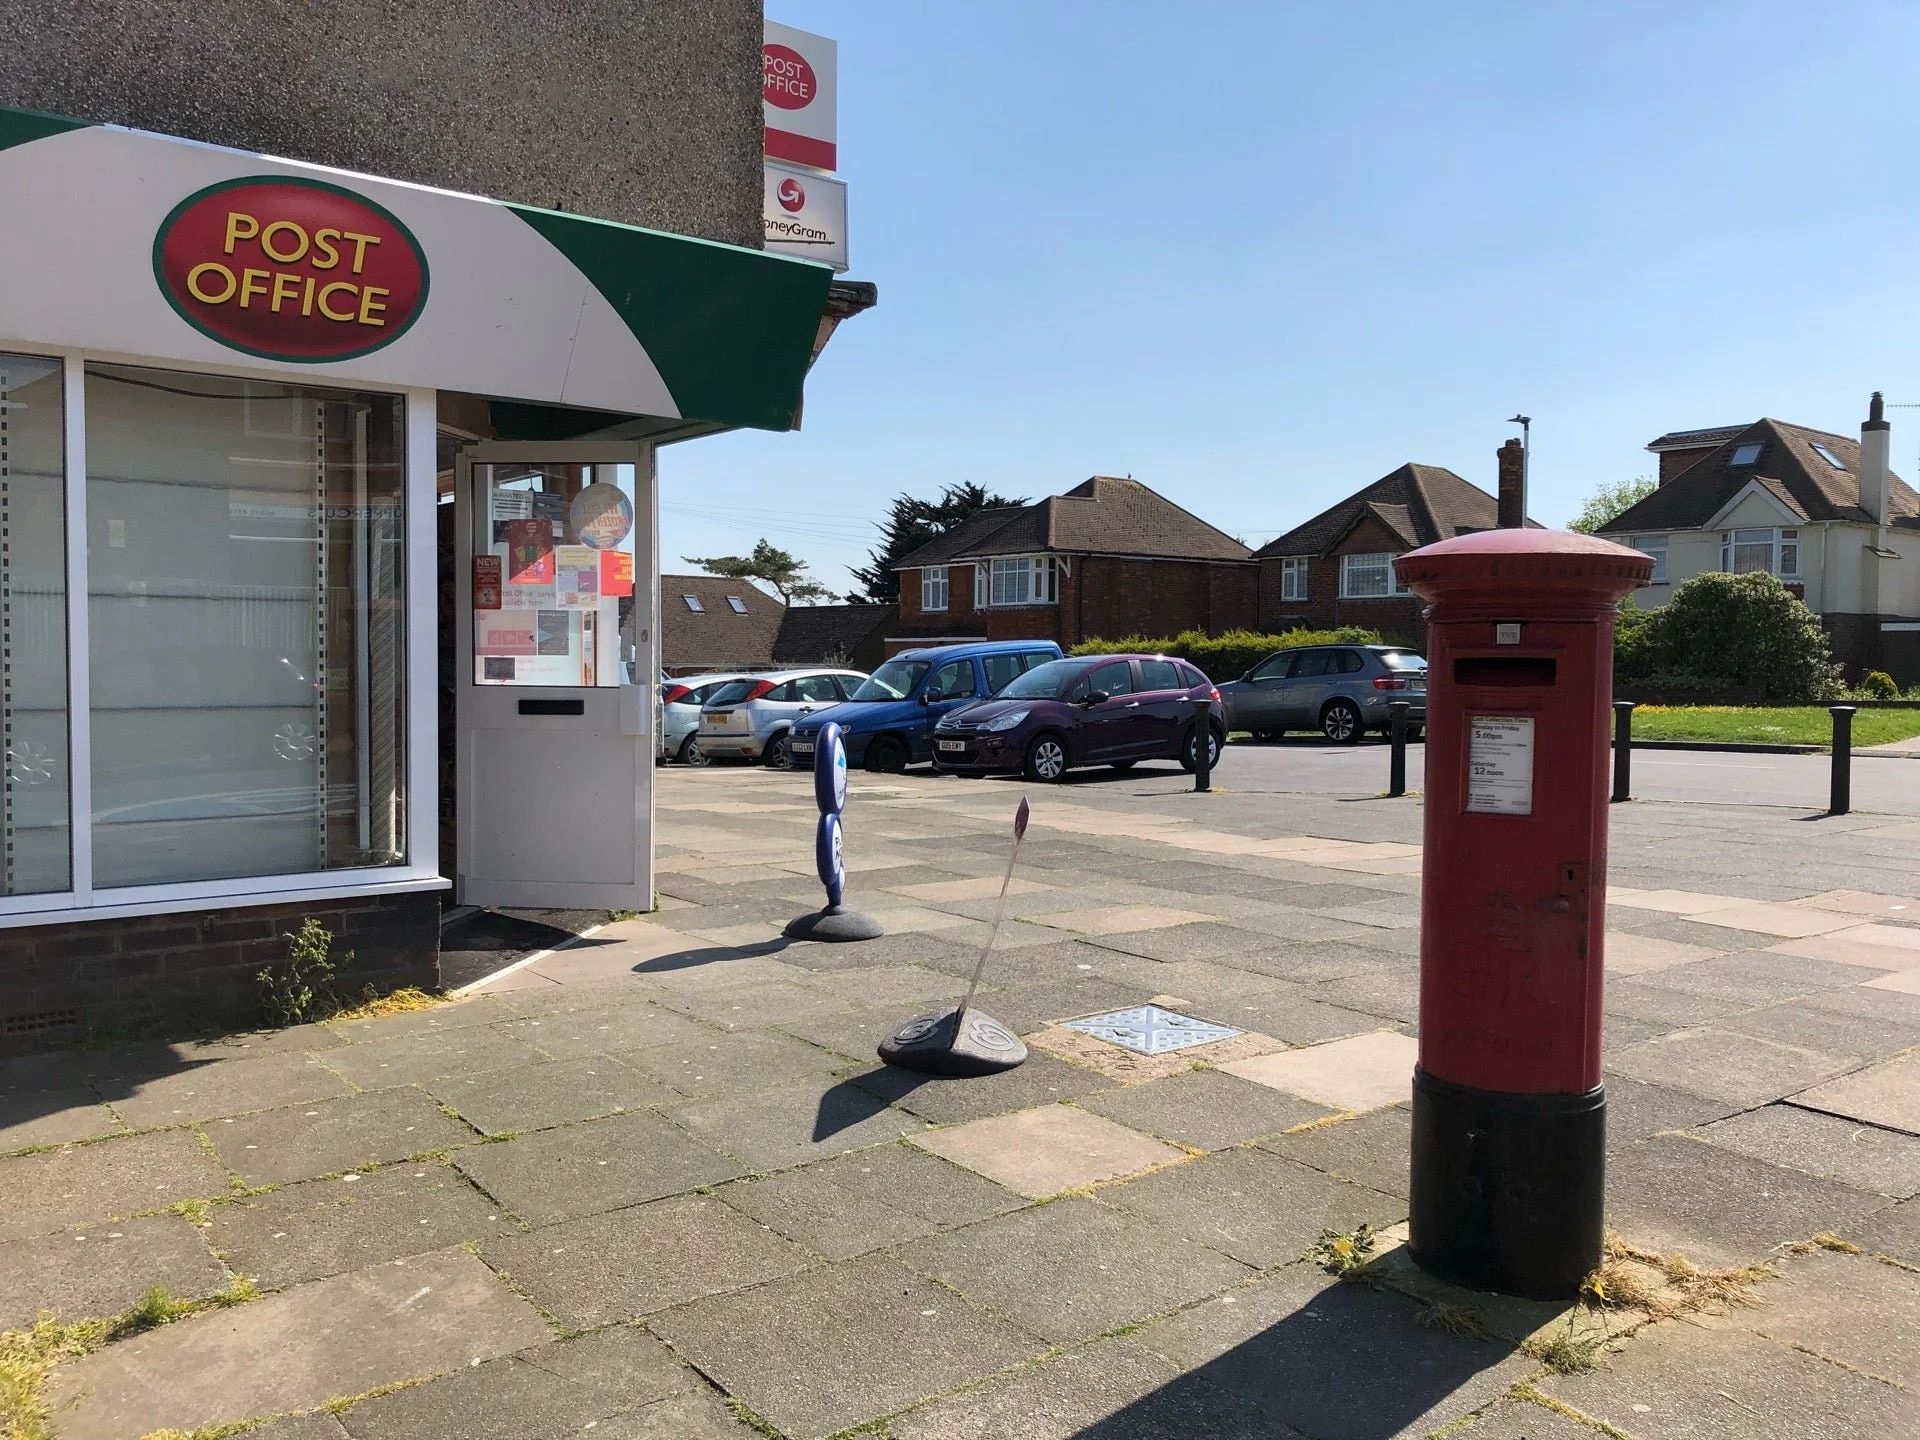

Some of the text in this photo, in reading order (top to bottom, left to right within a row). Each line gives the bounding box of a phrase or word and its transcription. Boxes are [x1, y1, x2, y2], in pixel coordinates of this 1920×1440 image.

[764, 54, 803, 79] POST
[764, 219, 827, 240] oneyGram
[224, 211, 381, 274] POST
[187, 262, 389, 327] OFFICE
[476, 557, 498, 567] NEW
[1470, 760, 1497, 768] Saturday
[1474, 767, 1486, 775] 12
